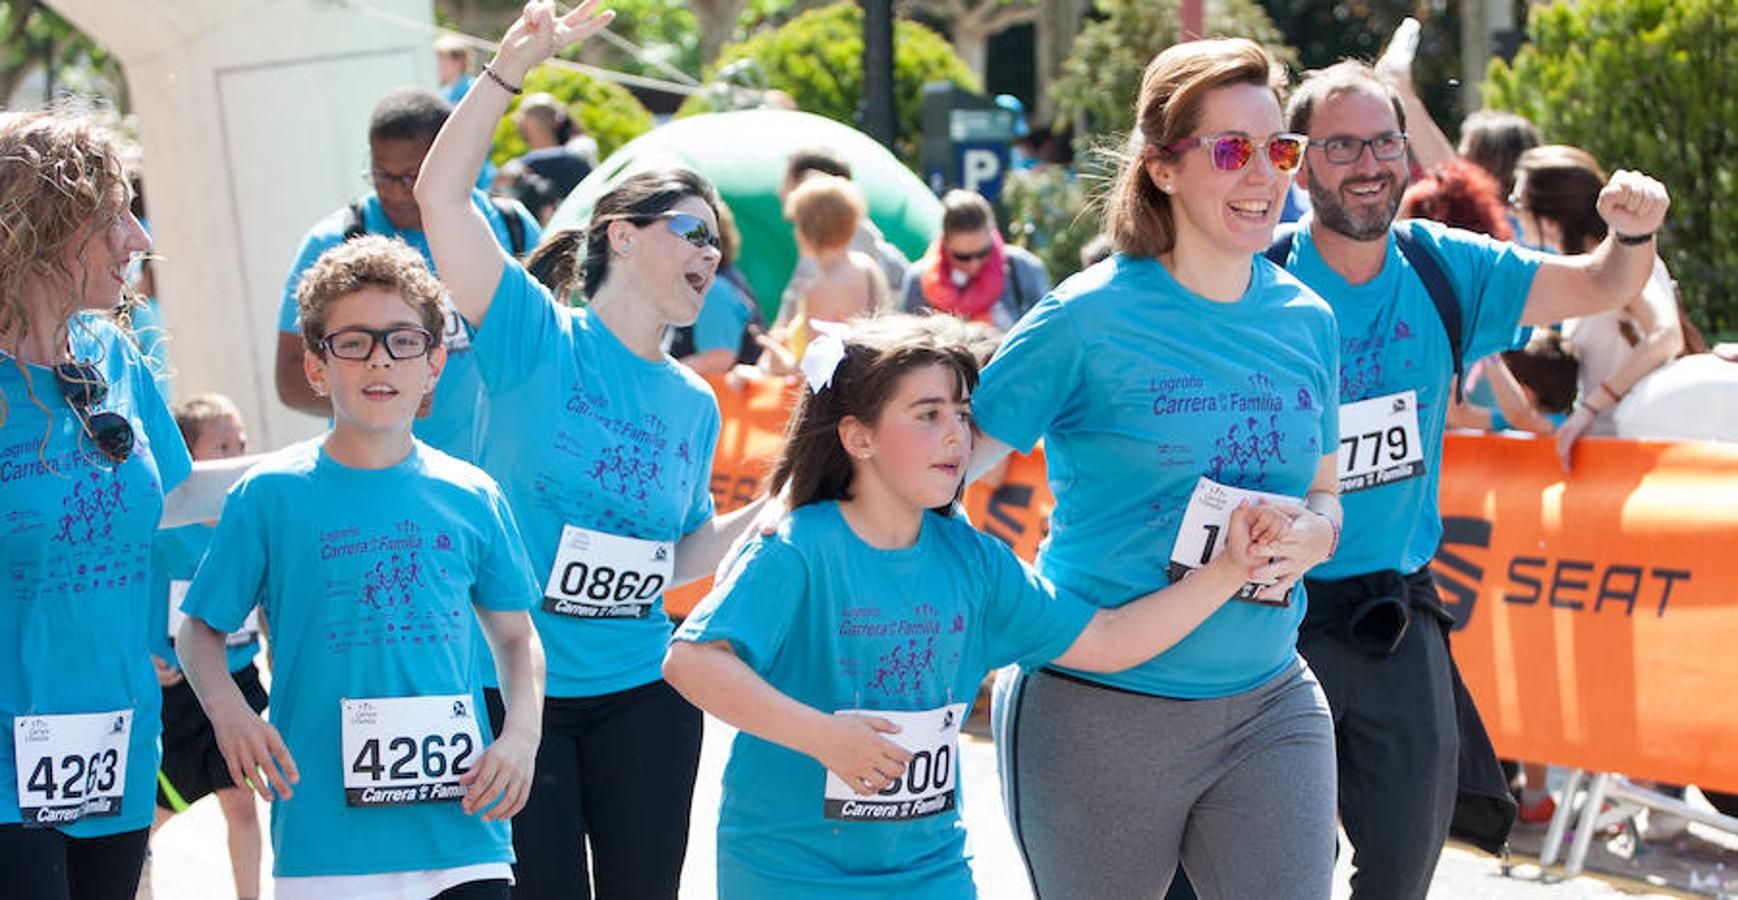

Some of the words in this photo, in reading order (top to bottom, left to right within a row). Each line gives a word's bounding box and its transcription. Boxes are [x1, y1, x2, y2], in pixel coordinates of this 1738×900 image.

[964, 150, 999, 190] P
[1153, 394, 1218, 416] Carrera
[1230, 391, 1284, 412] Familia
[1340, 427, 1409, 472] 779
[321, 541, 368, 560] Carrera
[560, 561, 664, 602] 0860
[1503, 555, 1692, 618] SEAT
[27, 748, 118, 800] 4263
[352, 732, 474, 781] 4262
[362, 786, 417, 803] Carrera
[841, 801, 898, 817] Carrera
